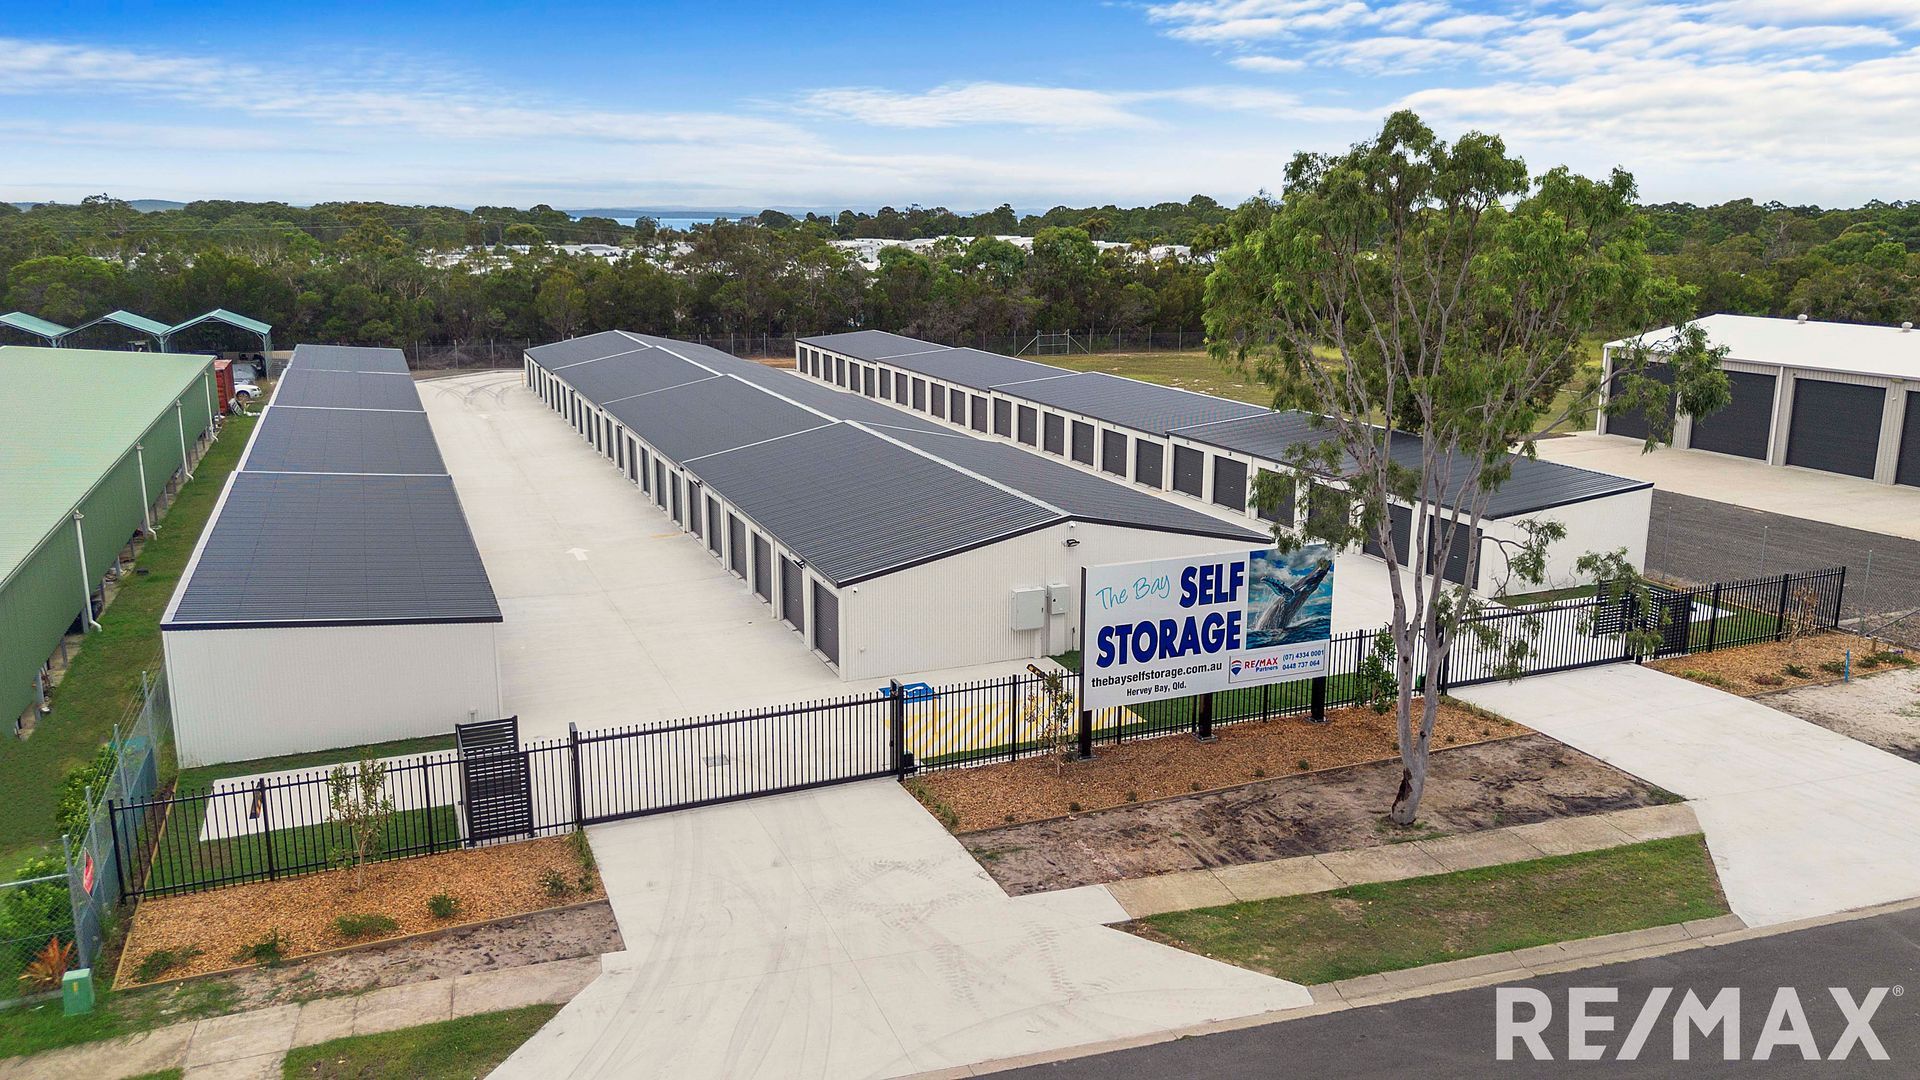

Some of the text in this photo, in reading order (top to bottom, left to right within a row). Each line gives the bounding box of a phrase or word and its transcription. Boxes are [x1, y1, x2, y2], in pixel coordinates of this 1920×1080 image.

[1096, 574, 1170, 610] The Bay
[1179, 561, 1246, 608] SELF
[1096, 610, 1242, 668] STORAGE
[1244, 657, 1278, 669] RE/MAX
[1282, 653, 1295, 661] (07)
[1295, 651, 1310, 659] 4334
[1091, 662, 1223, 688] thebayselfstorage.com.au
[1255, 665, 1279, 673] Partners
[1126, 680, 1187, 697] Hervey Bay, Qld.
